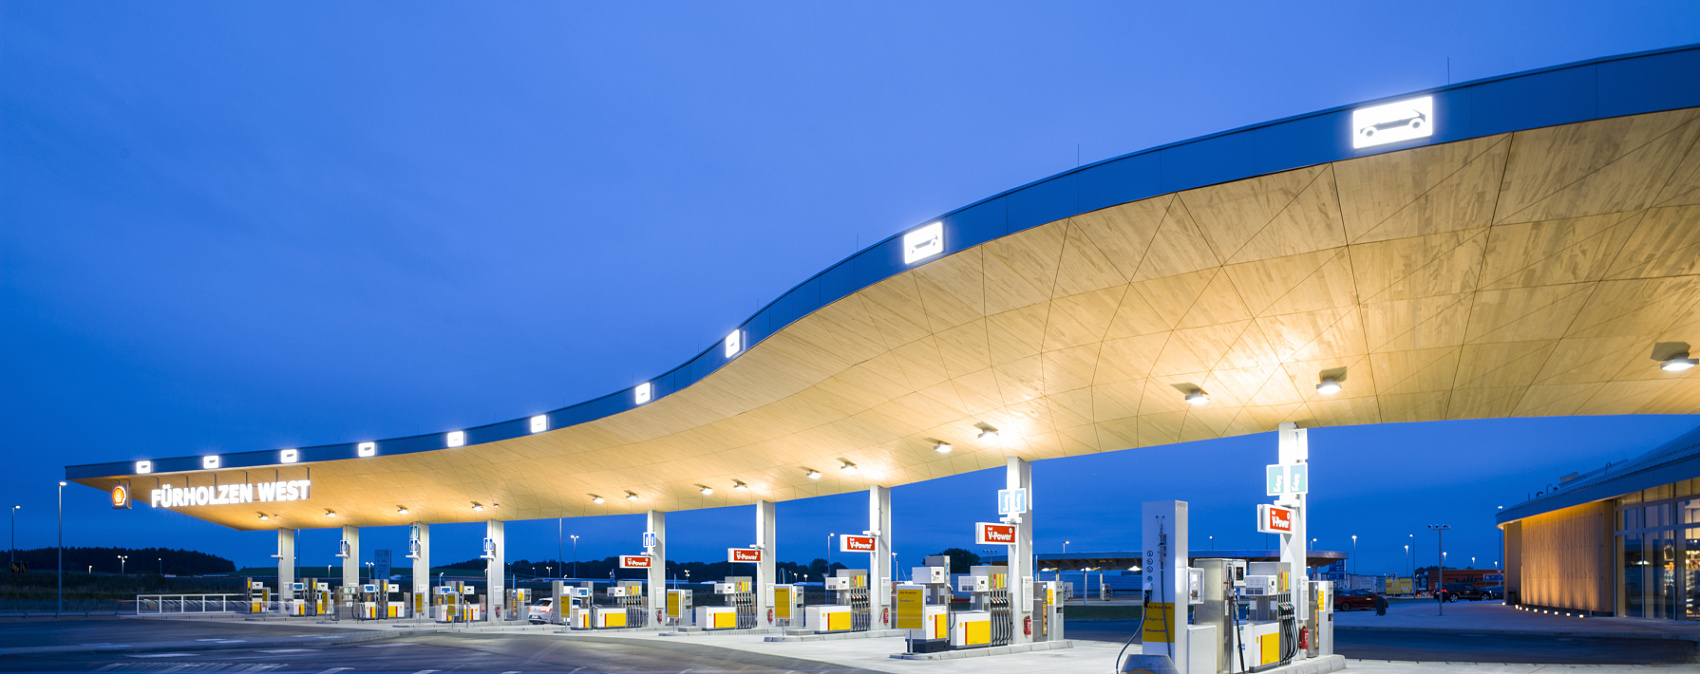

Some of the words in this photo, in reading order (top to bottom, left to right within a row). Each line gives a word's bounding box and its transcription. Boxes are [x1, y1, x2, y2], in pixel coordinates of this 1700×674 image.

[151, 483, 254, 508] FÜRHOLZEN
[257, 480, 311, 502] WEST
[987, 531, 1012, 541] V-Power
[849, 541, 872, 549] V-Power
